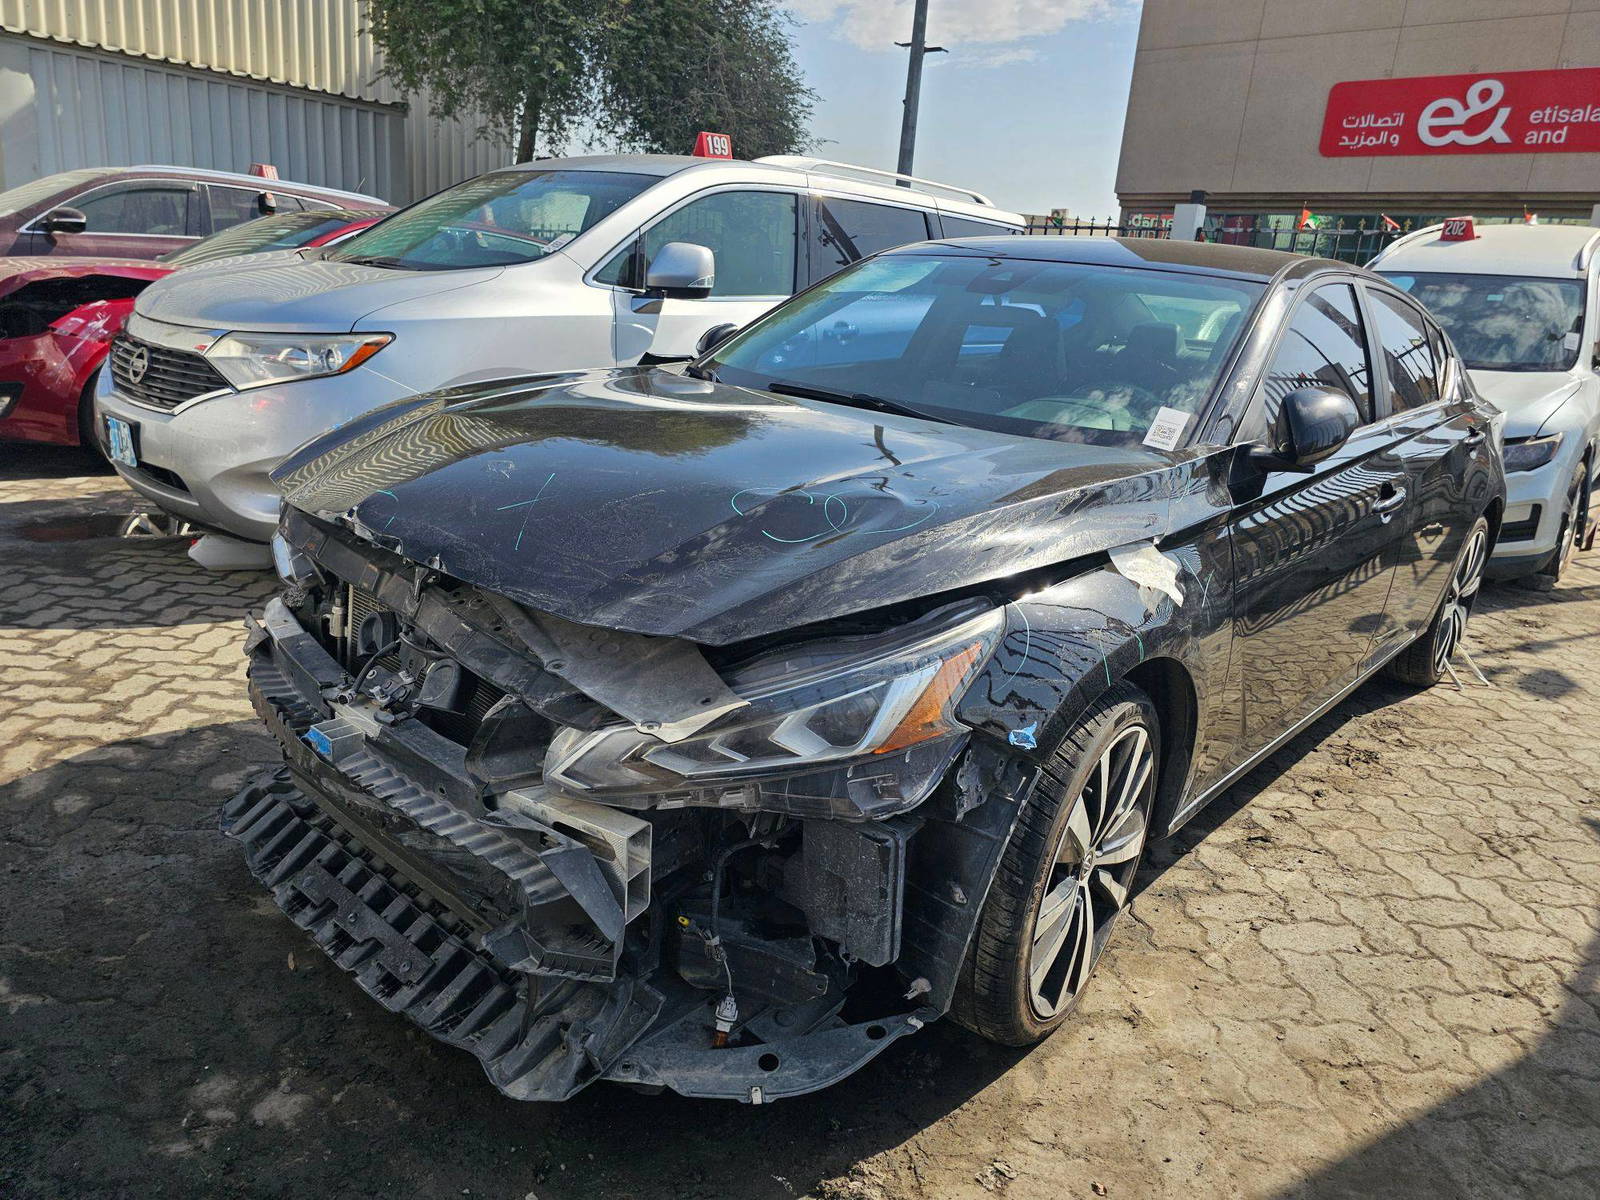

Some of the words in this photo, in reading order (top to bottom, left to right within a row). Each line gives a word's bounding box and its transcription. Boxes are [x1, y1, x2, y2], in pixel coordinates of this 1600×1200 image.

[1342, 112, 1404, 128] اتصالات
[1524, 125, 1568, 144] and
[706, 135, 729, 156] 199
[1445, 220, 1467, 236] 202
